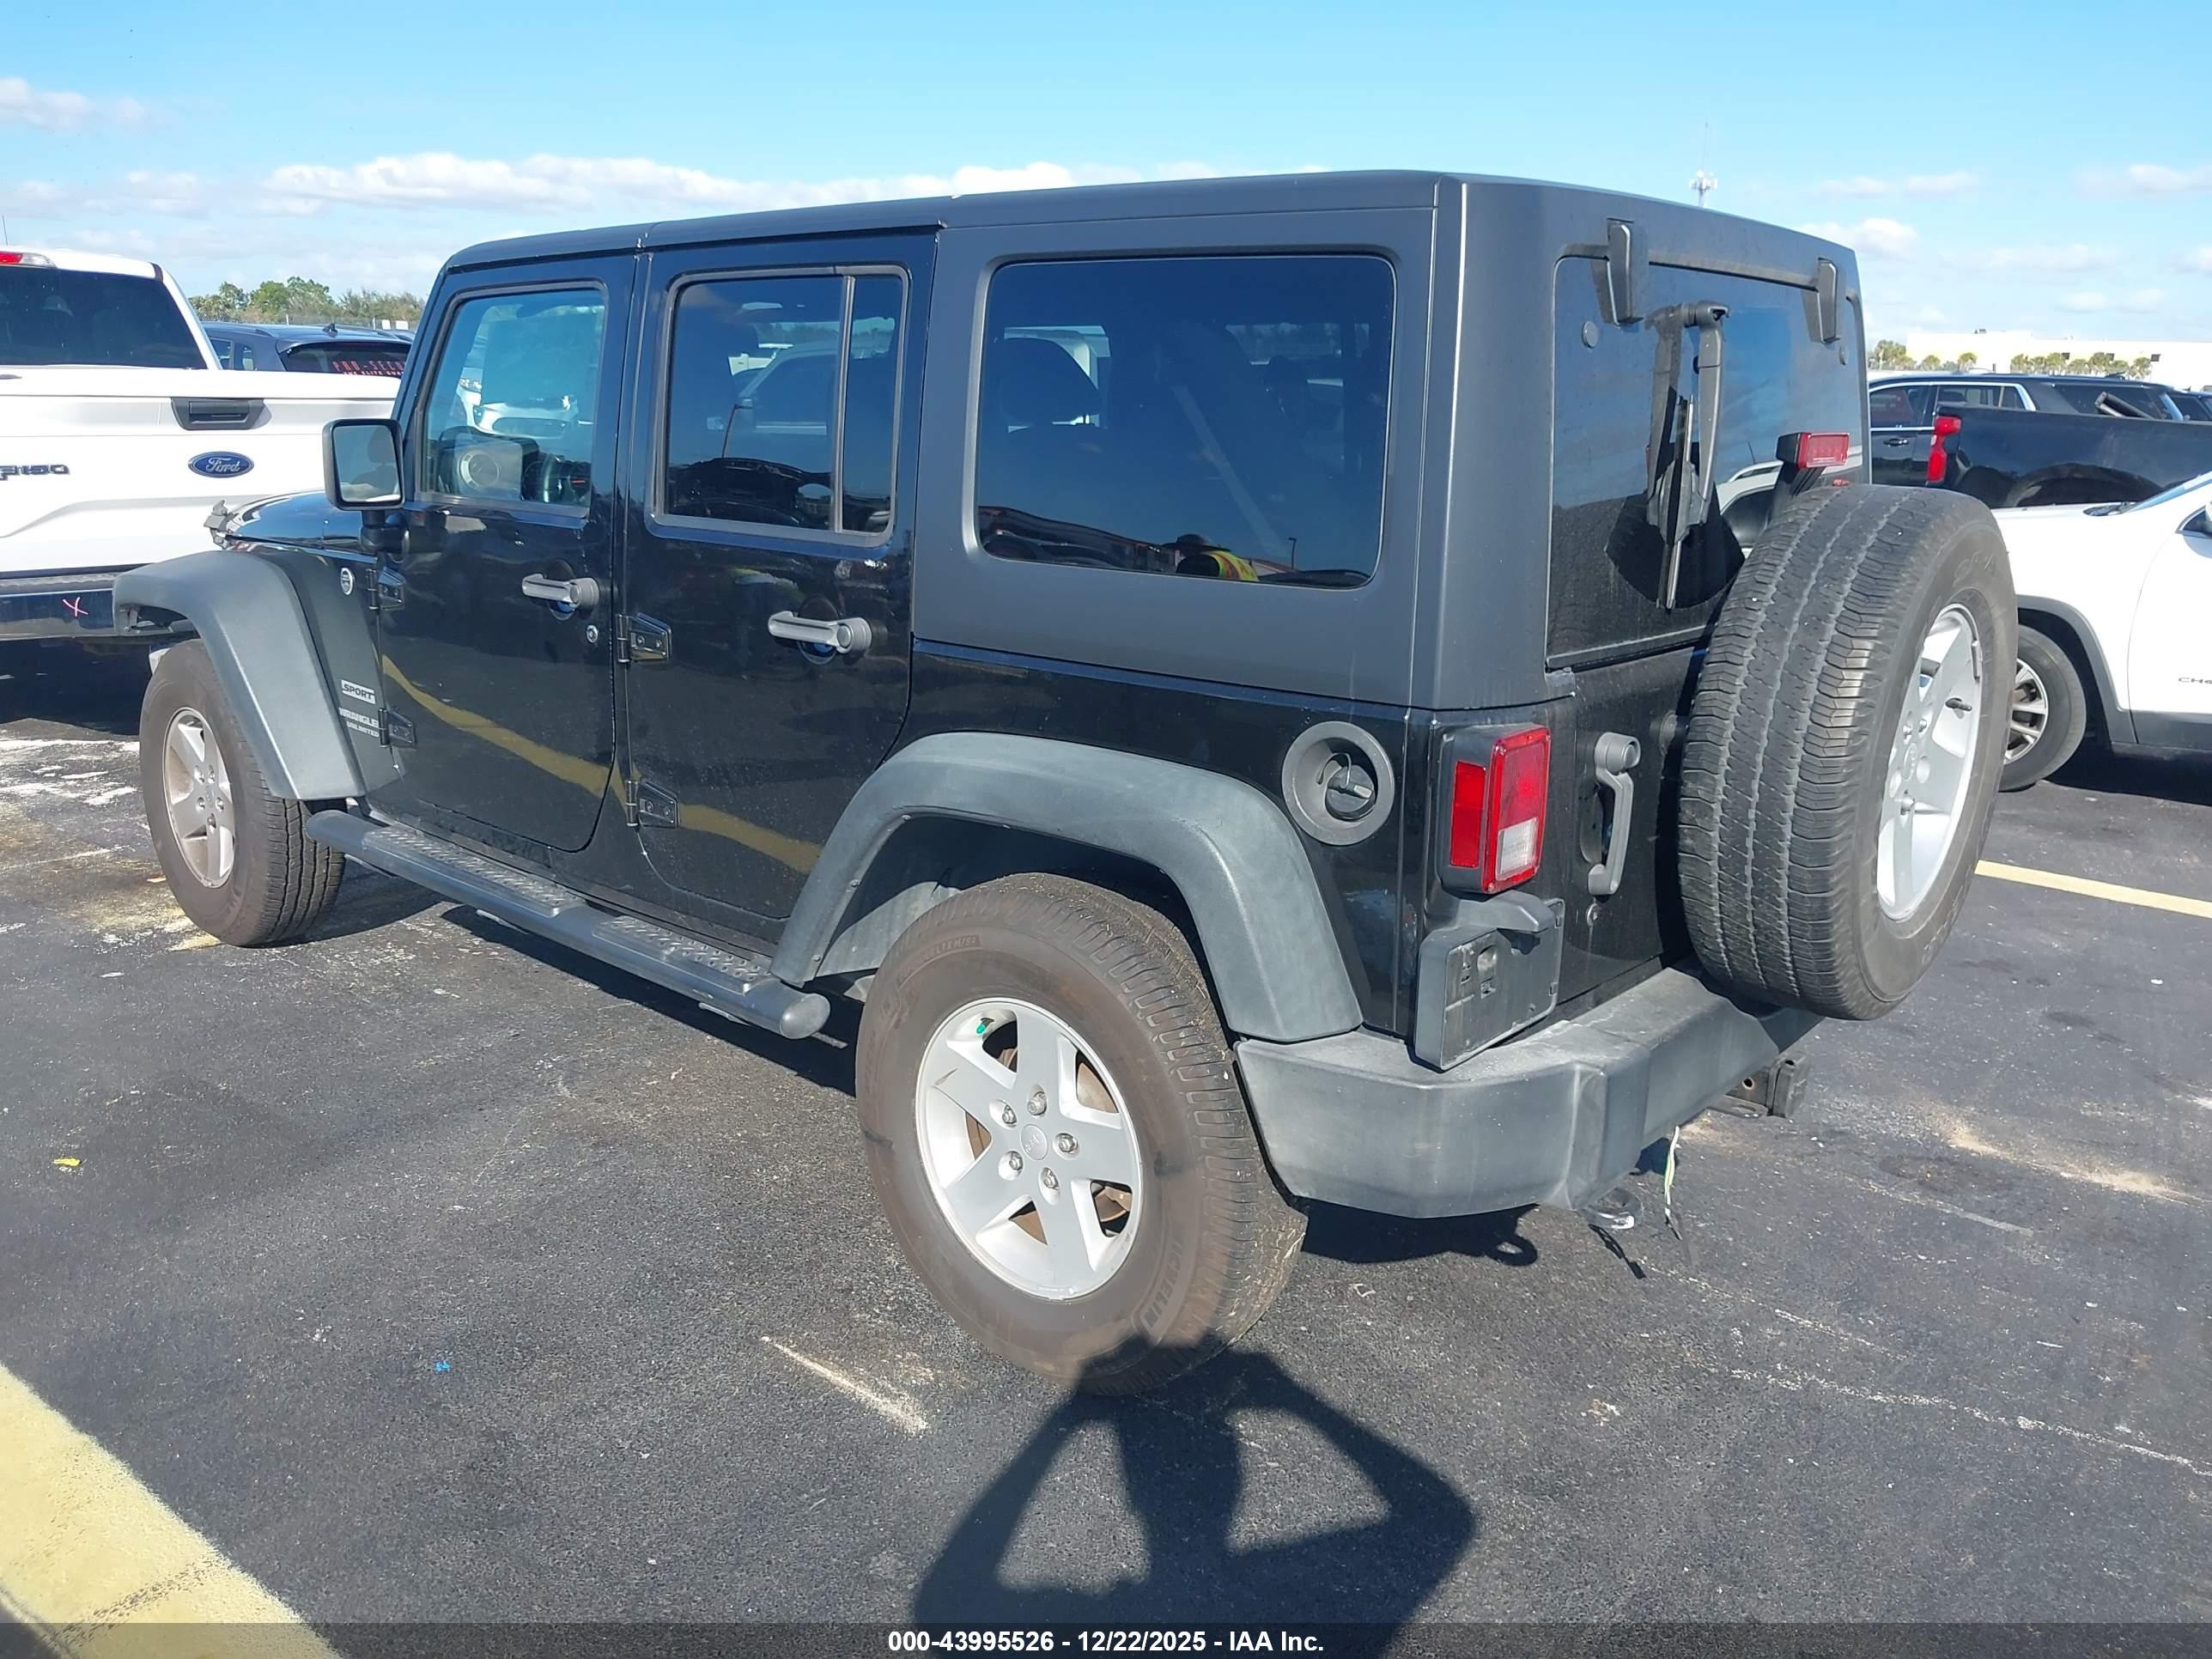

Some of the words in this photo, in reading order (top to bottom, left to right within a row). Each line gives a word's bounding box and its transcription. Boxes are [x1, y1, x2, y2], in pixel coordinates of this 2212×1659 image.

[205, 457, 240, 472] Ford
[343, 684, 375, 700] SPORT
[338, 707, 379, 728] WRANGLE
[1143, 1228, 1185, 1328] ICHELIN
